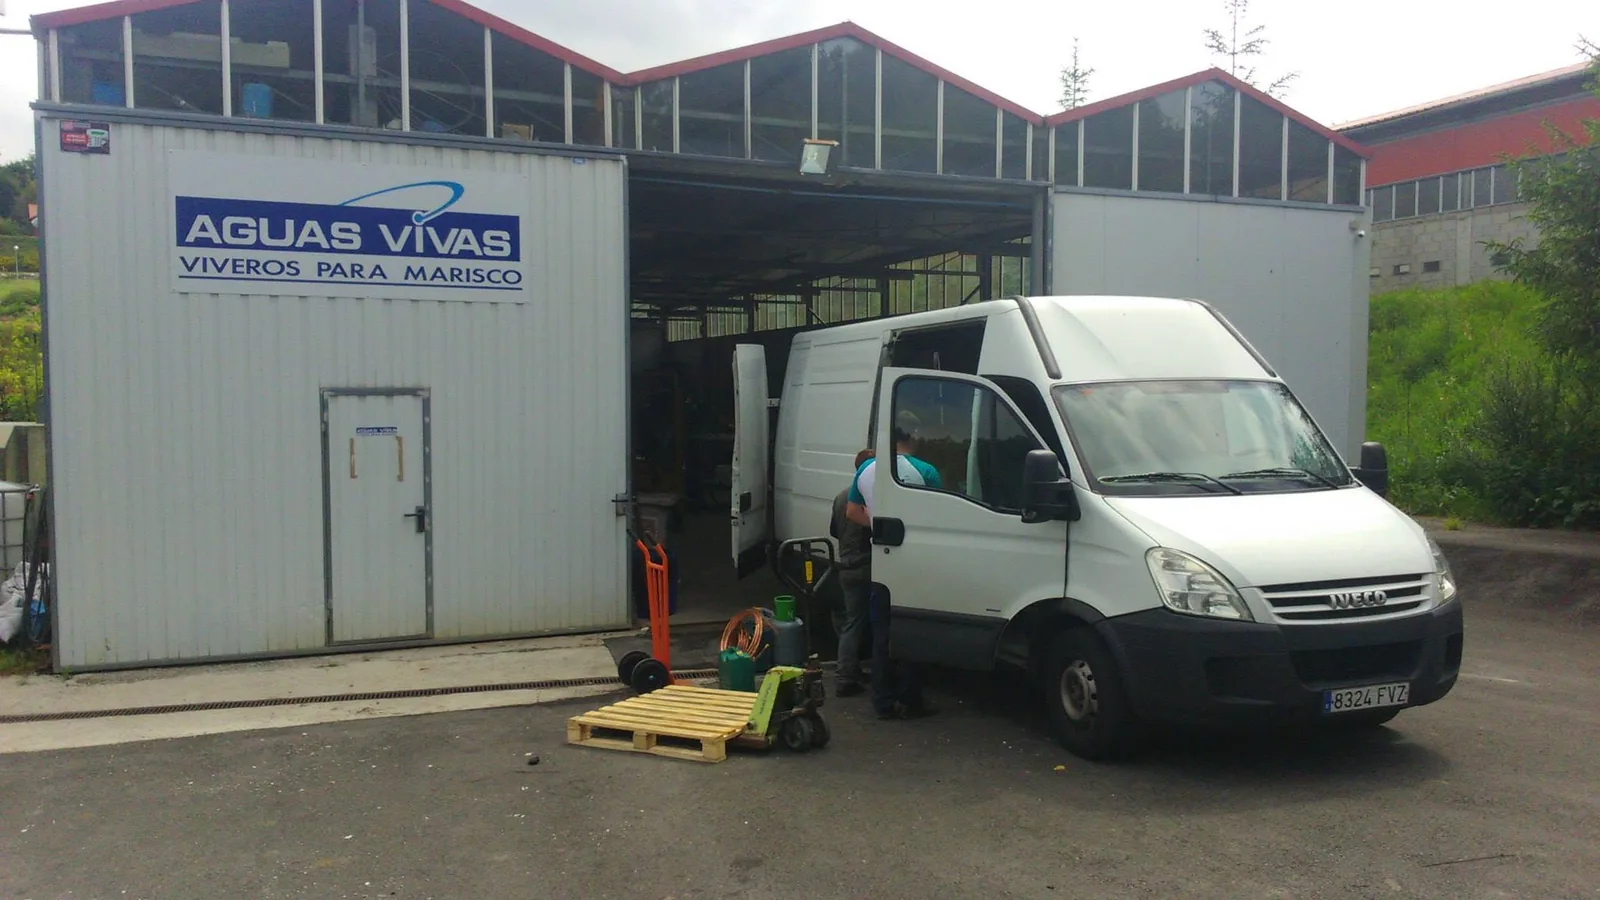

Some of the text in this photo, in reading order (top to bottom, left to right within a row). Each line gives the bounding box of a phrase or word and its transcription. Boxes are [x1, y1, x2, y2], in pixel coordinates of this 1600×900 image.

[185, 214, 512, 258] AGUAS VIVAS
[179, 256, 523, 285] VIVEROS PARA MARISCO
[1328, 590, 1388, 610] IVECO
[1334, 689, 1372, 709] 8324
[1377, 685, 1406, 704] FVZ
